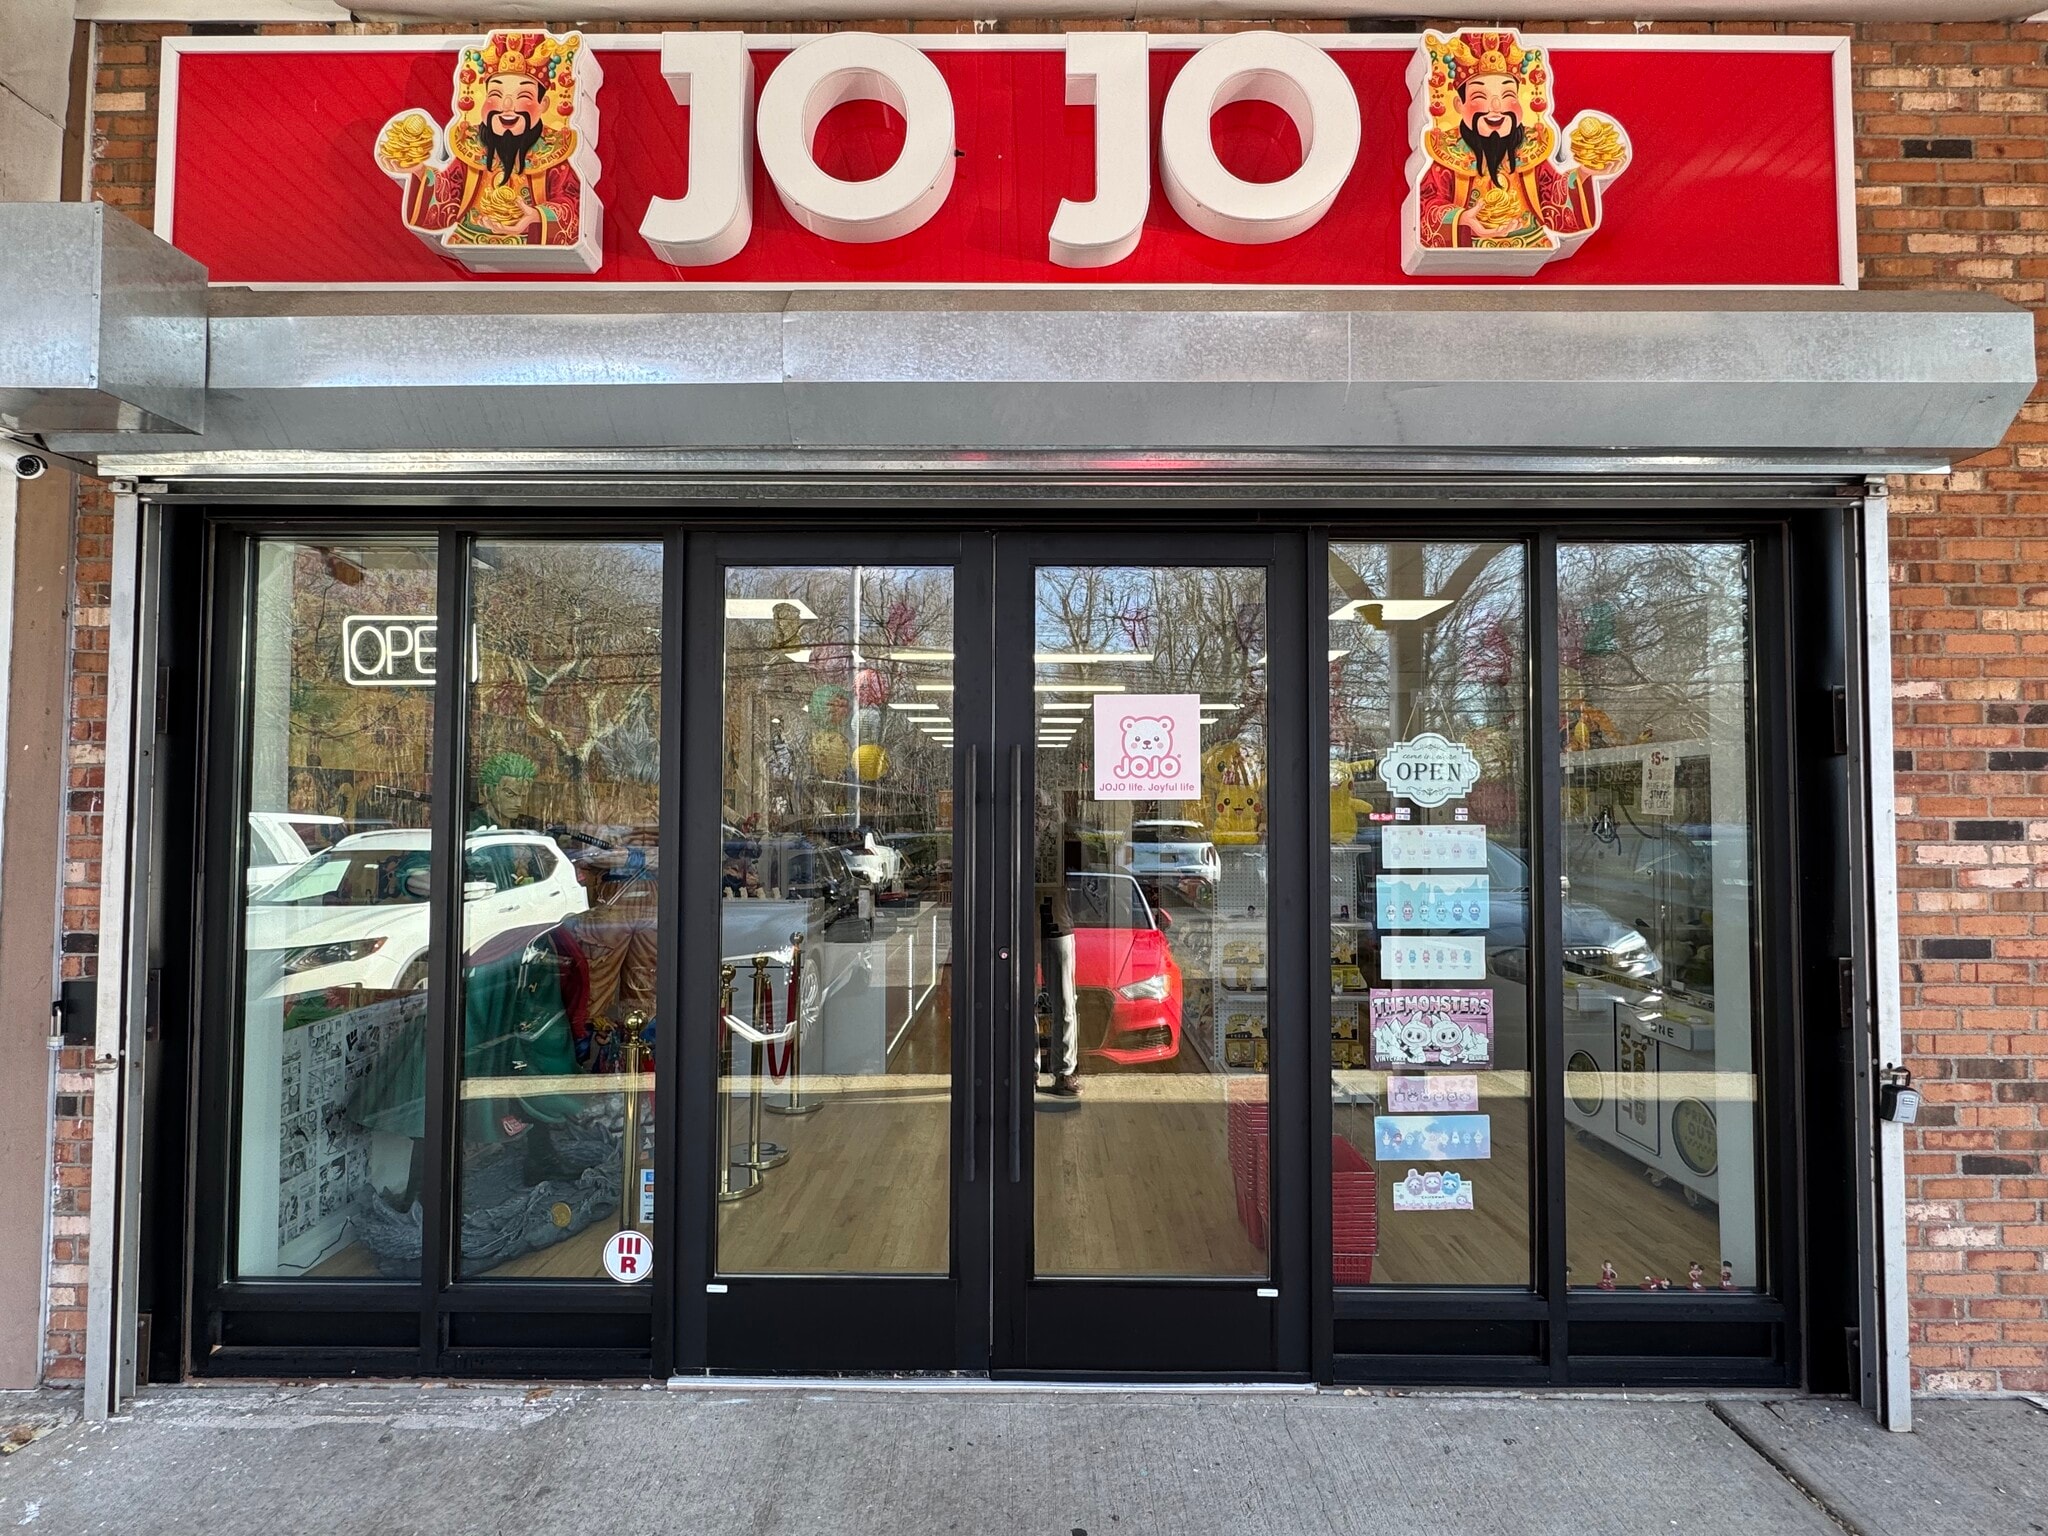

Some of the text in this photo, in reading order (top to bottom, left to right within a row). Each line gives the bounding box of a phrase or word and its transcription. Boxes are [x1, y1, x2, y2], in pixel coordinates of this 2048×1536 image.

[350, 625, 438, 675] OPE
[1113, 755, 1181, 779] JOJO
[1396, 762, 1463, 781] OPEN
[1099, 782, 1195, 793] JOJO life. Joyful life
